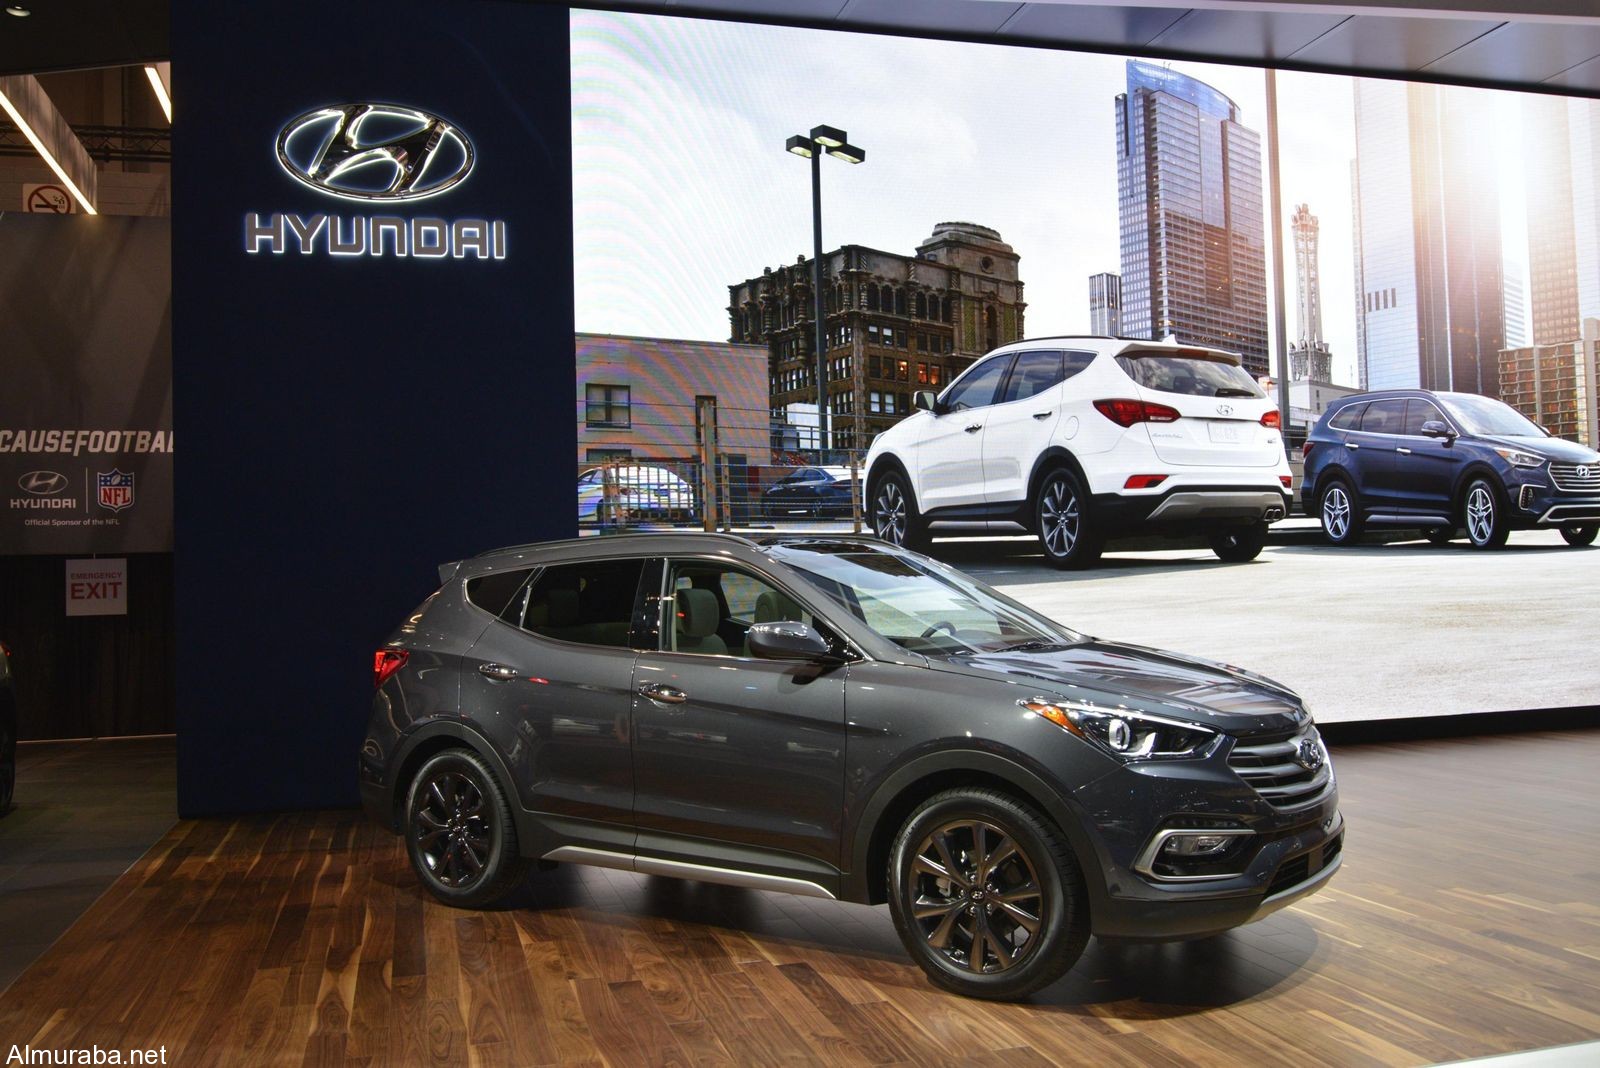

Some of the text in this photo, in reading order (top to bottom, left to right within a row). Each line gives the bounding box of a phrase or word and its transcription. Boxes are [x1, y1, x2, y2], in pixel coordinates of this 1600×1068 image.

[245, 212, 506, 259] HYUNDAI
[10, 498, 76, 509] HYUNDAI
[101, 487, 131, 506] NFL
[51, 519, 81, 527] Sponsor
[82, 518, 91, 526] of
[92, 518, 104, 526] the
[105, 518, 120, 526] NFL
[70, 571, 123, 580] EMERGENCY
[70, 581, 122, 600] EXIT
